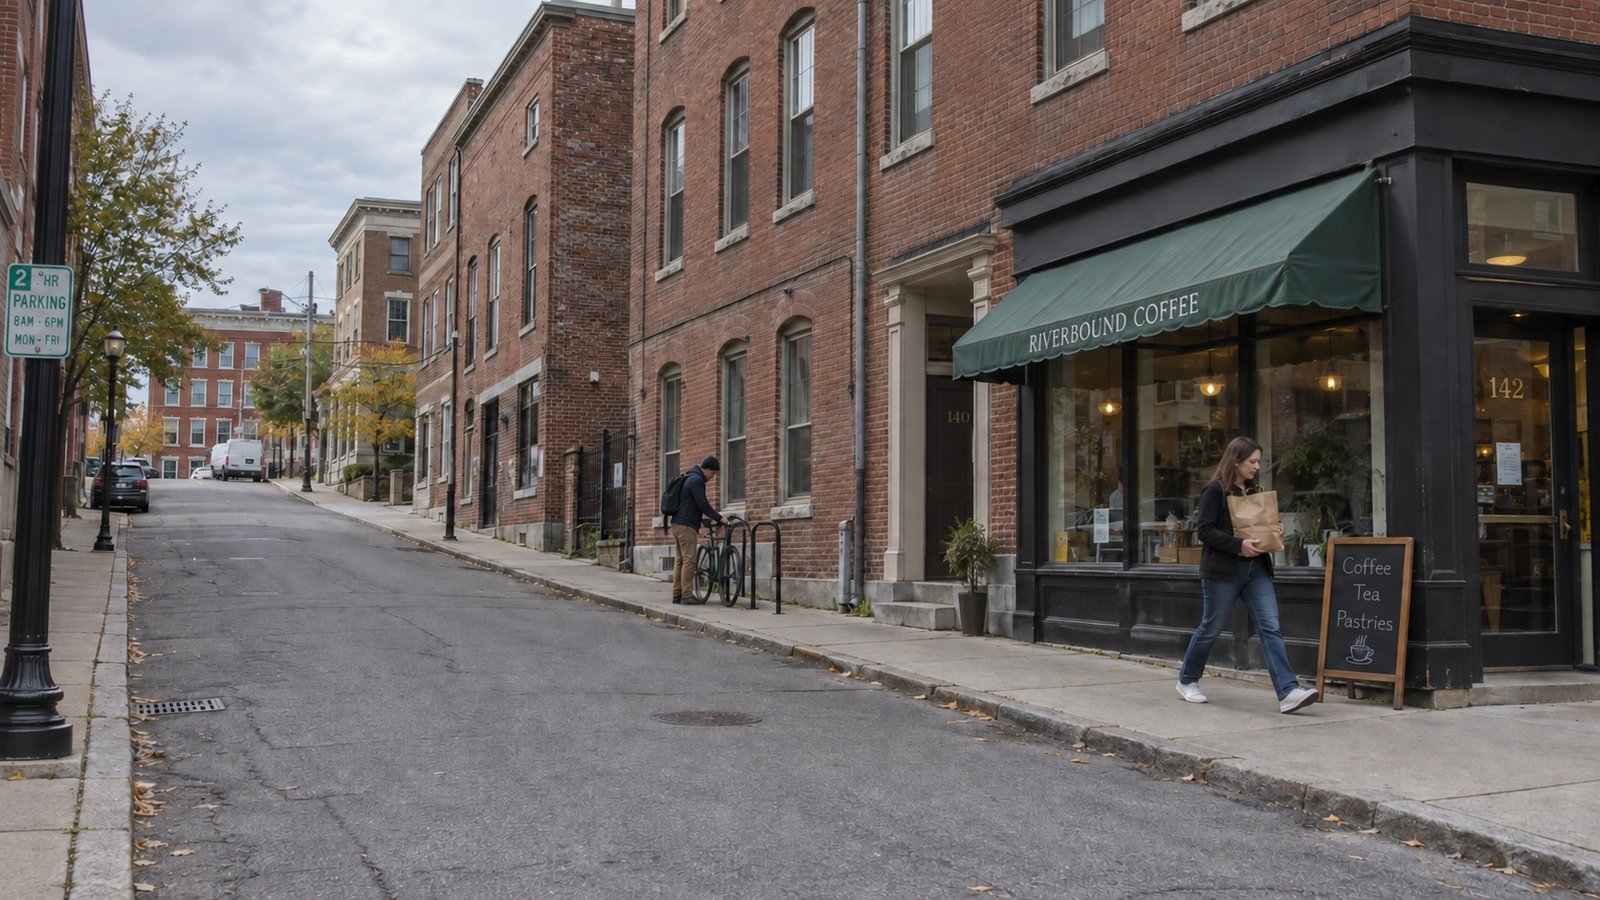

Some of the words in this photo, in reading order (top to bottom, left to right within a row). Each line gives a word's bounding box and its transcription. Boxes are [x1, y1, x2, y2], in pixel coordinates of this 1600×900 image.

[15, 269, 27, 286] 2
[44, 274, 59, 287] HR
[13, 293, 66, 310] PARKING
[14, 315, 34, 326] 8AM
[44, 317, 64, 328] 6PM
[1028, 311, 1128, 353] RIVERBOUND
[1132, 291, 1199, 327] COFFEE
[14, 334, 35, 345] MON
[45, 335, 60, 345] FRI
[1489, 376, 1524, 399] 142
[948, 410, 970, 423] 140
[1342, 556, 1392, 576] Coffee
[1353, 583, 1381, 602] Tea
[1336, 609, 1394, 632] Pastries
